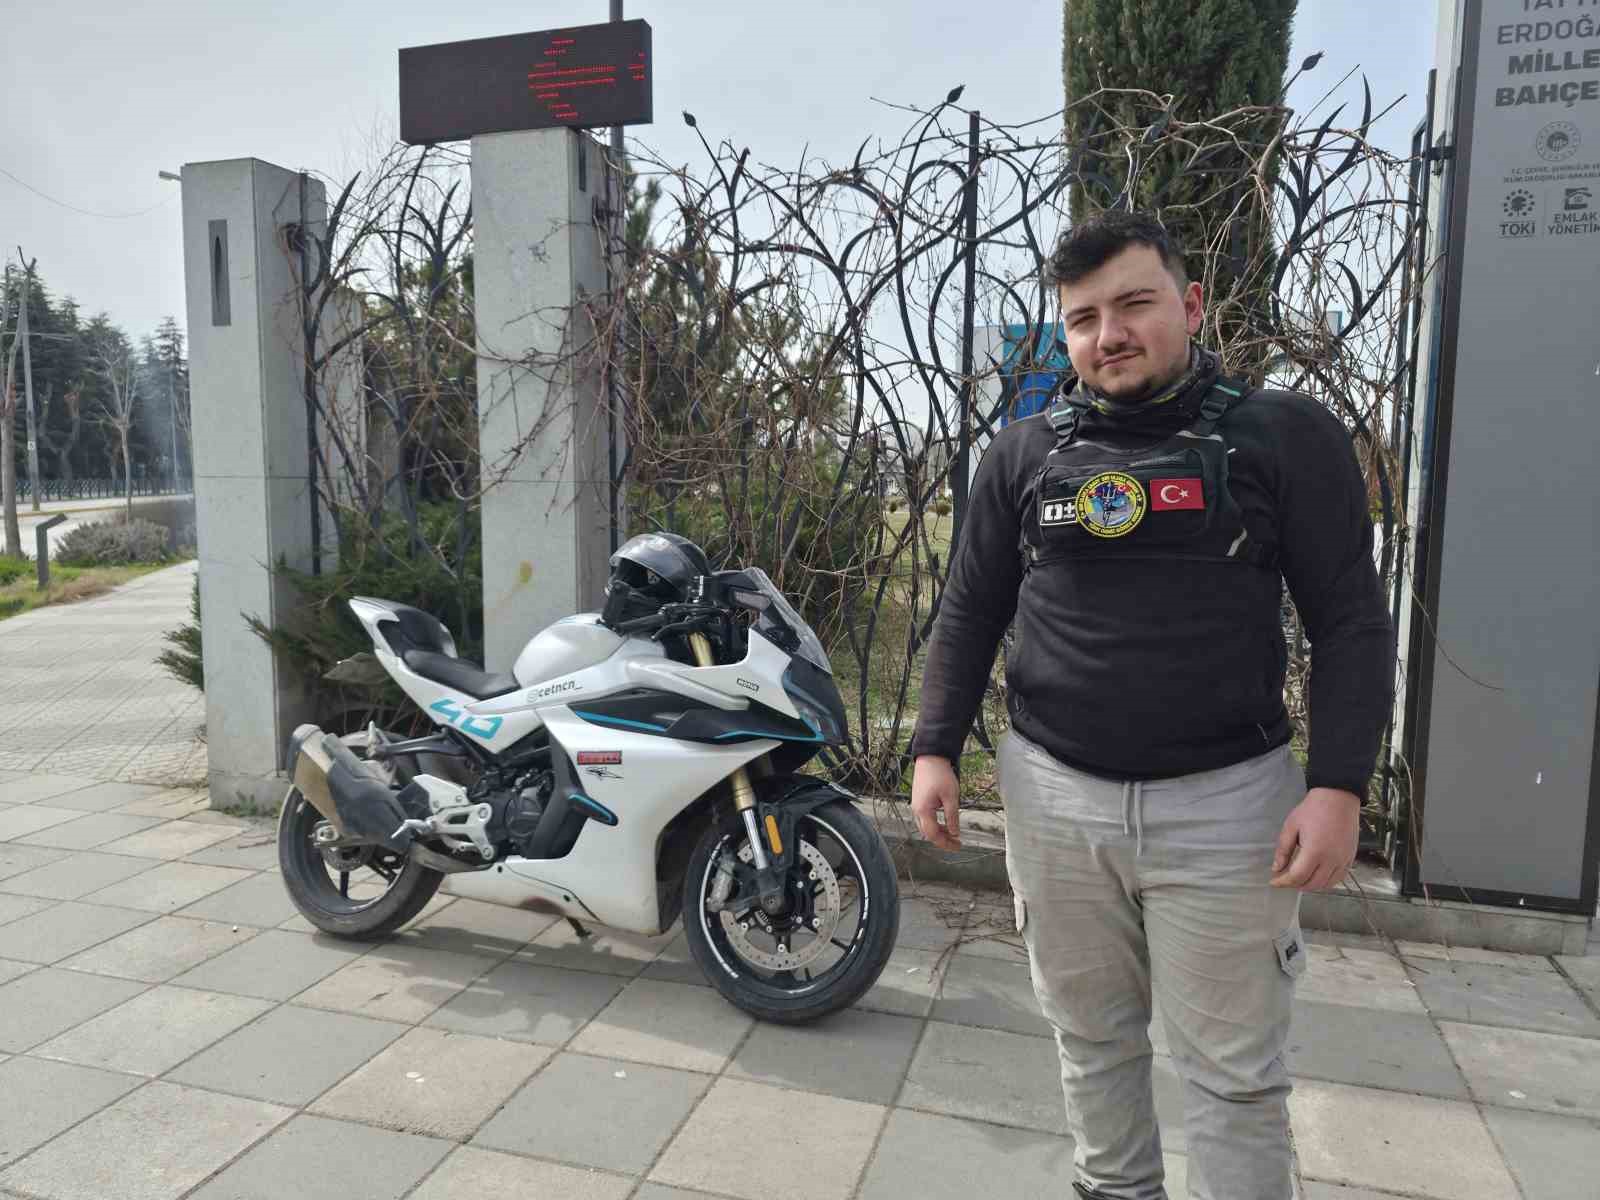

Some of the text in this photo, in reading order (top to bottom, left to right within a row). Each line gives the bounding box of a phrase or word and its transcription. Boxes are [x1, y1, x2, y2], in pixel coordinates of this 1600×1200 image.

[1497, 13, 1600, 45] ERDOĞ
[1508, 48, 1600, 75] MİLLE
[1495, 80, 1600, 108] BAHÇE
[1553, 211, 1598, 223] EMLAK
